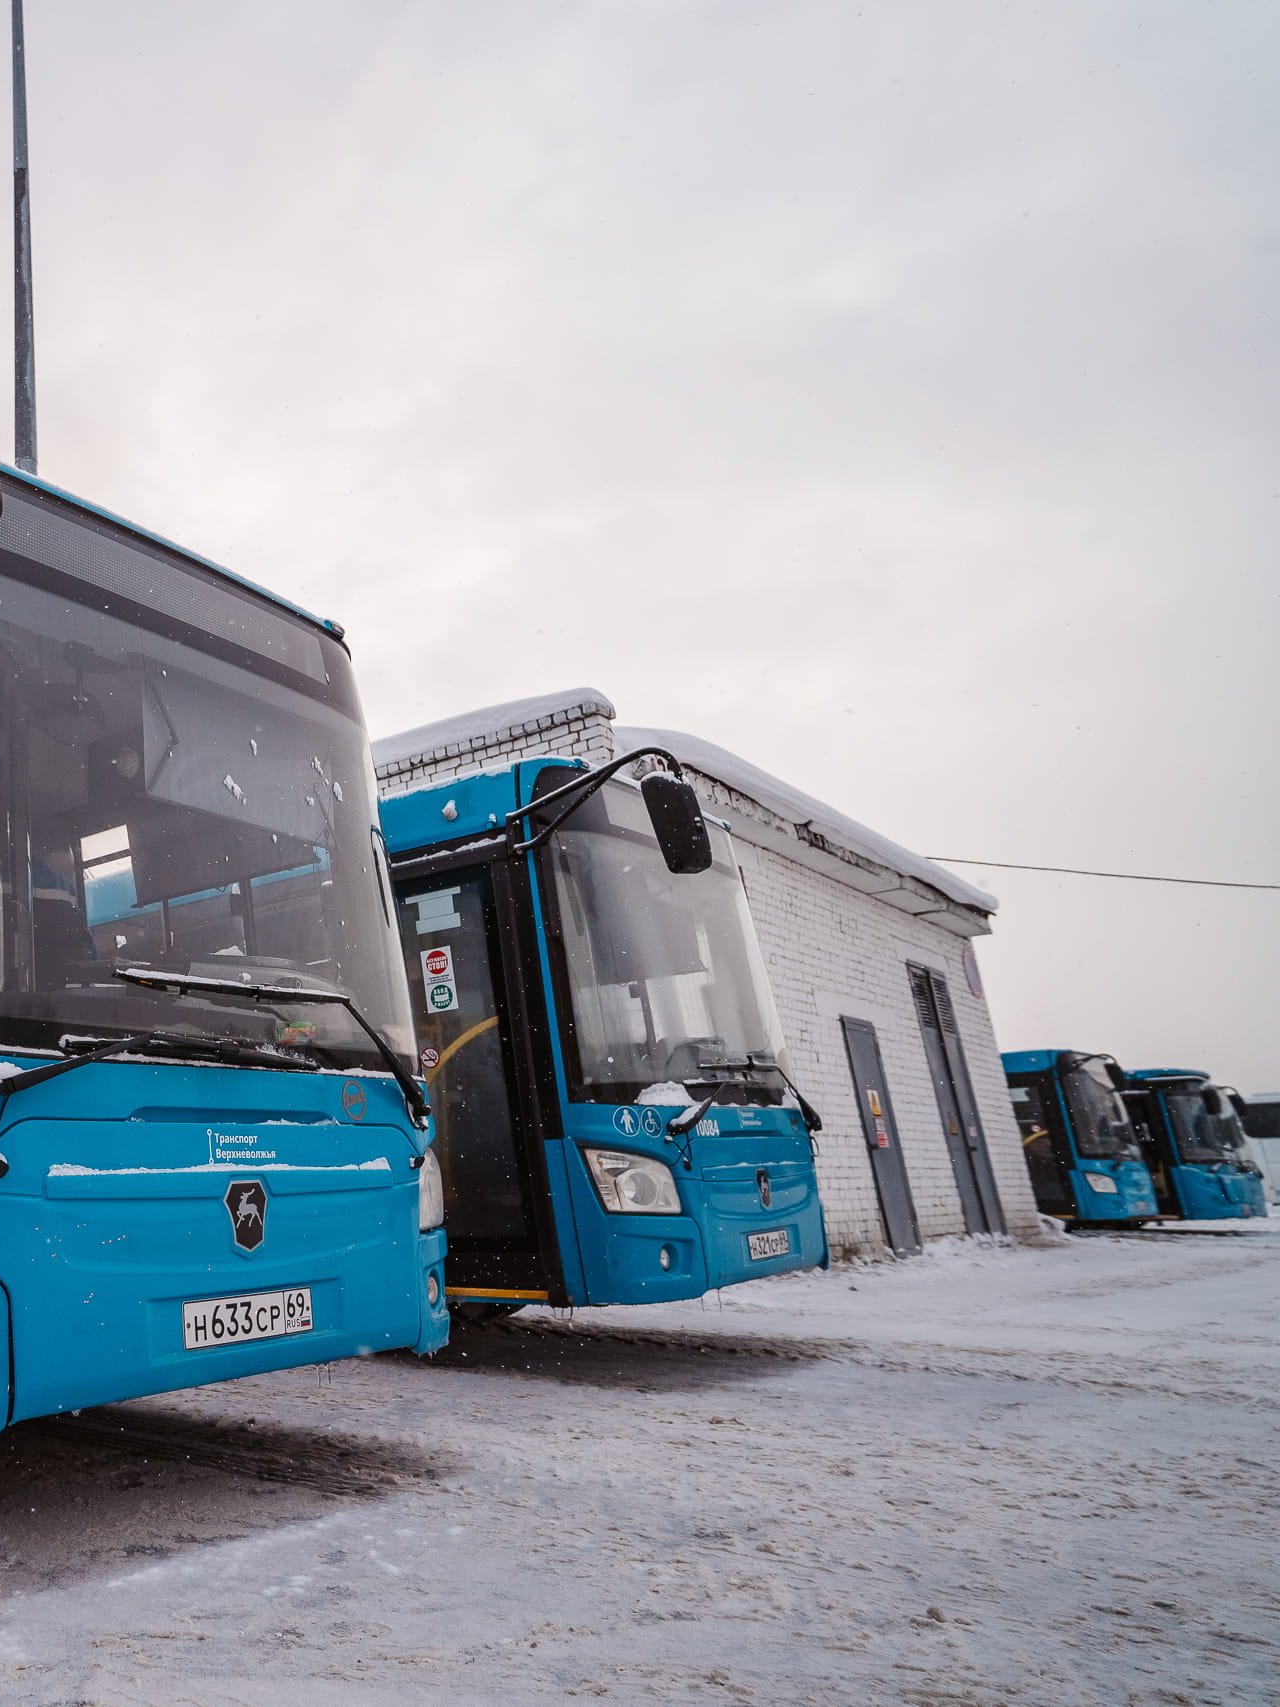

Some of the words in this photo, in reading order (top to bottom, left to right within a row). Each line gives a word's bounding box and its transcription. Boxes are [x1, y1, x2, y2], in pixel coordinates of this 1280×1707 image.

[695, 1119, 720, 1136] 10084
[214, 1132, 258, 1146] Транспорт
[215, 1148, 276, 1161] Верхневолжья
[286, 1292, 305, 1318] 69
[286, 1318, 301, 1329] RUS
